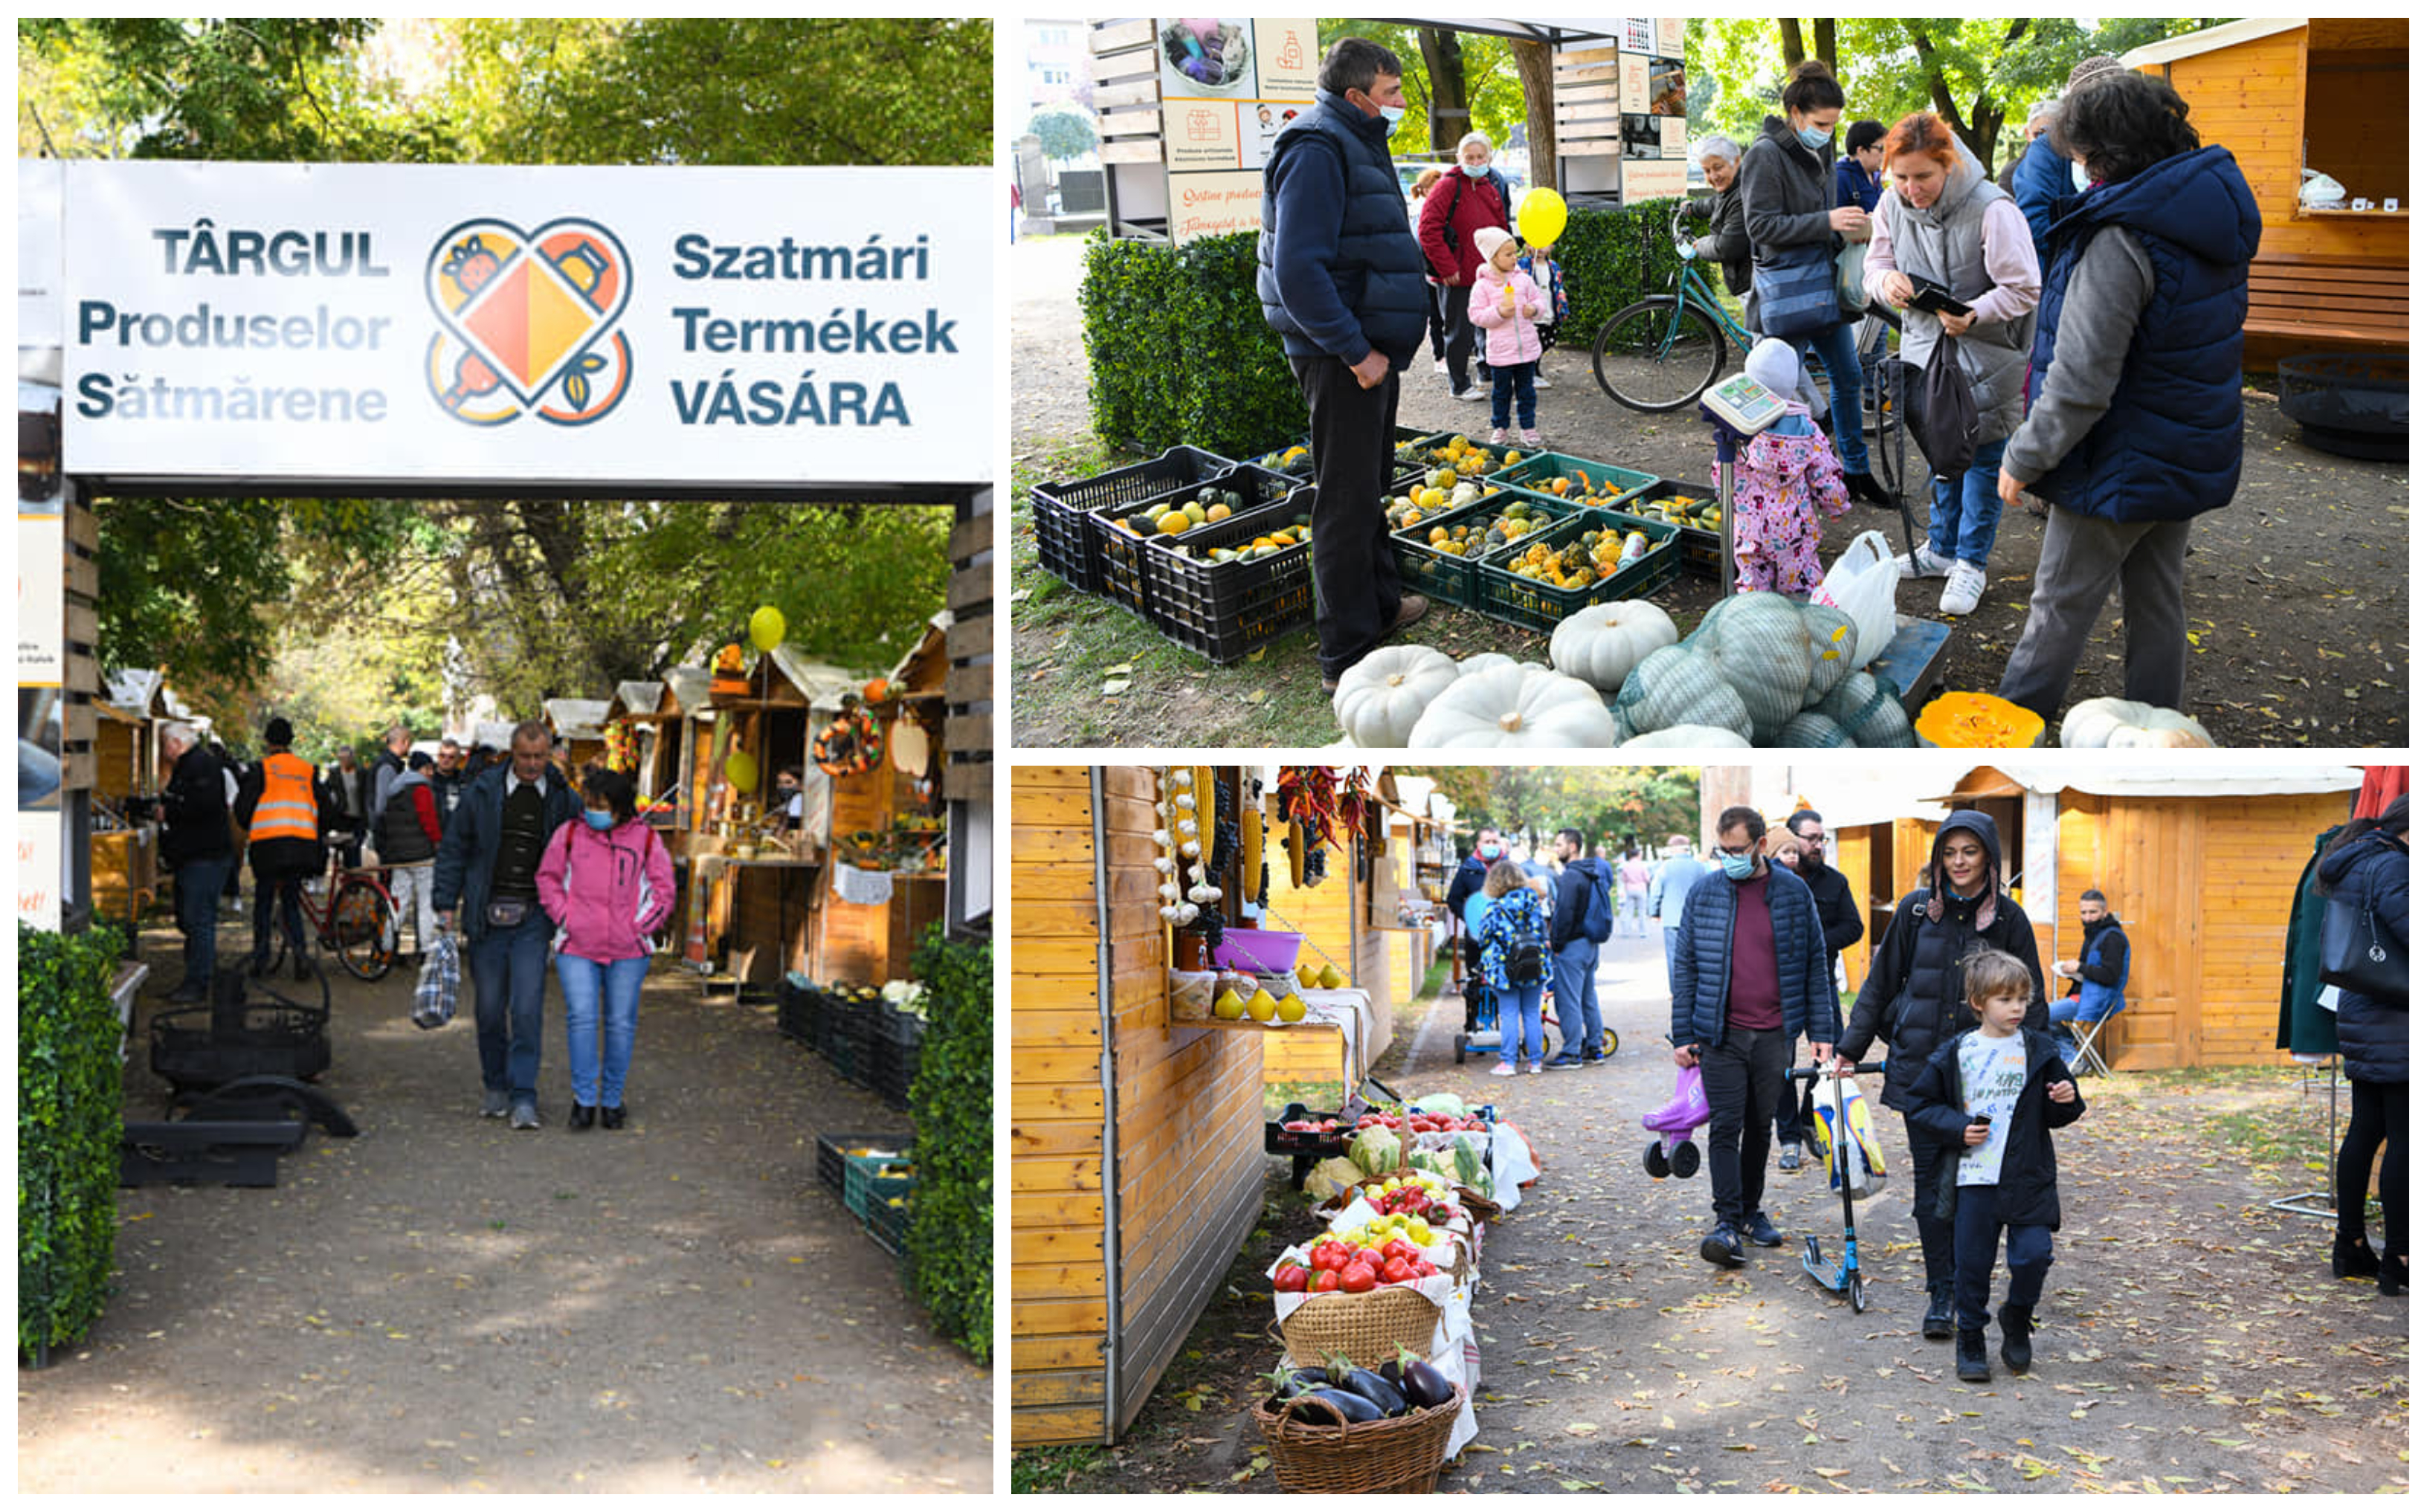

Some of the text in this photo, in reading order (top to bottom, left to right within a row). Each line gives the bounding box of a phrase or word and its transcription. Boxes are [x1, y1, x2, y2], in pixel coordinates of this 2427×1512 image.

[152, 218, 390, 277] TÂRGUL
[673, 233, 929, 280] Szatmári
[79, 300, 391, 349] Produselor
[672, 307, 959, 354] Termékek
[77, 372, 387, 421] Sătmărene
[670, 369, 912, 427] VÁSÁRA
